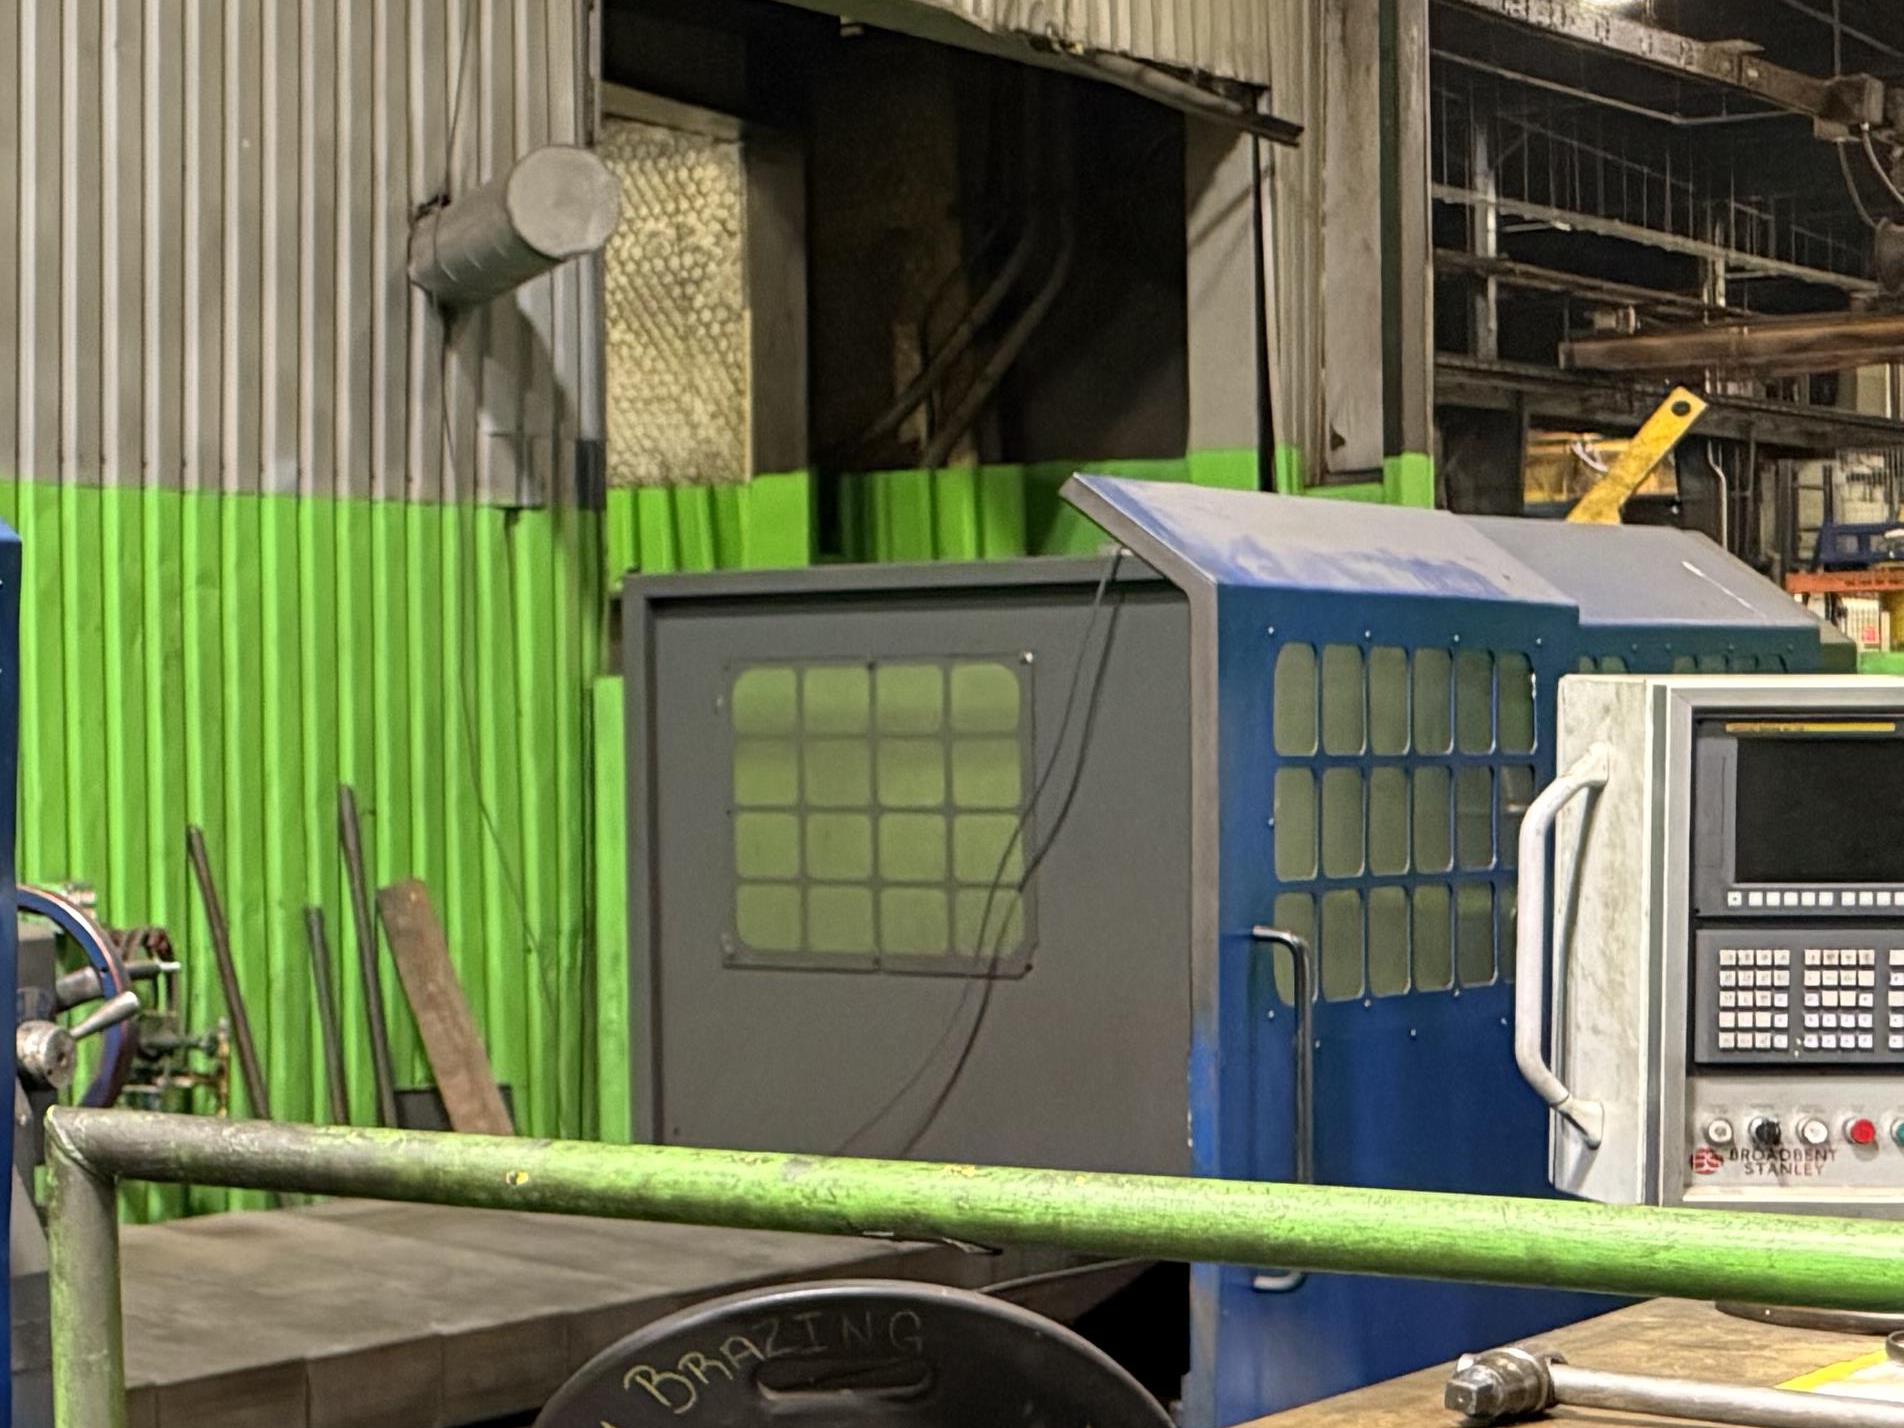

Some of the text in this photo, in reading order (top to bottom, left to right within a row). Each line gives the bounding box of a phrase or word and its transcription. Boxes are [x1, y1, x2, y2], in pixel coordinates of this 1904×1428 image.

[1729, 1147, 1838, 1162] BROADBENT
[1744, 1162, 1826, 1177] STANLEY
[623, 1308, 925, 1415] BRAZING
